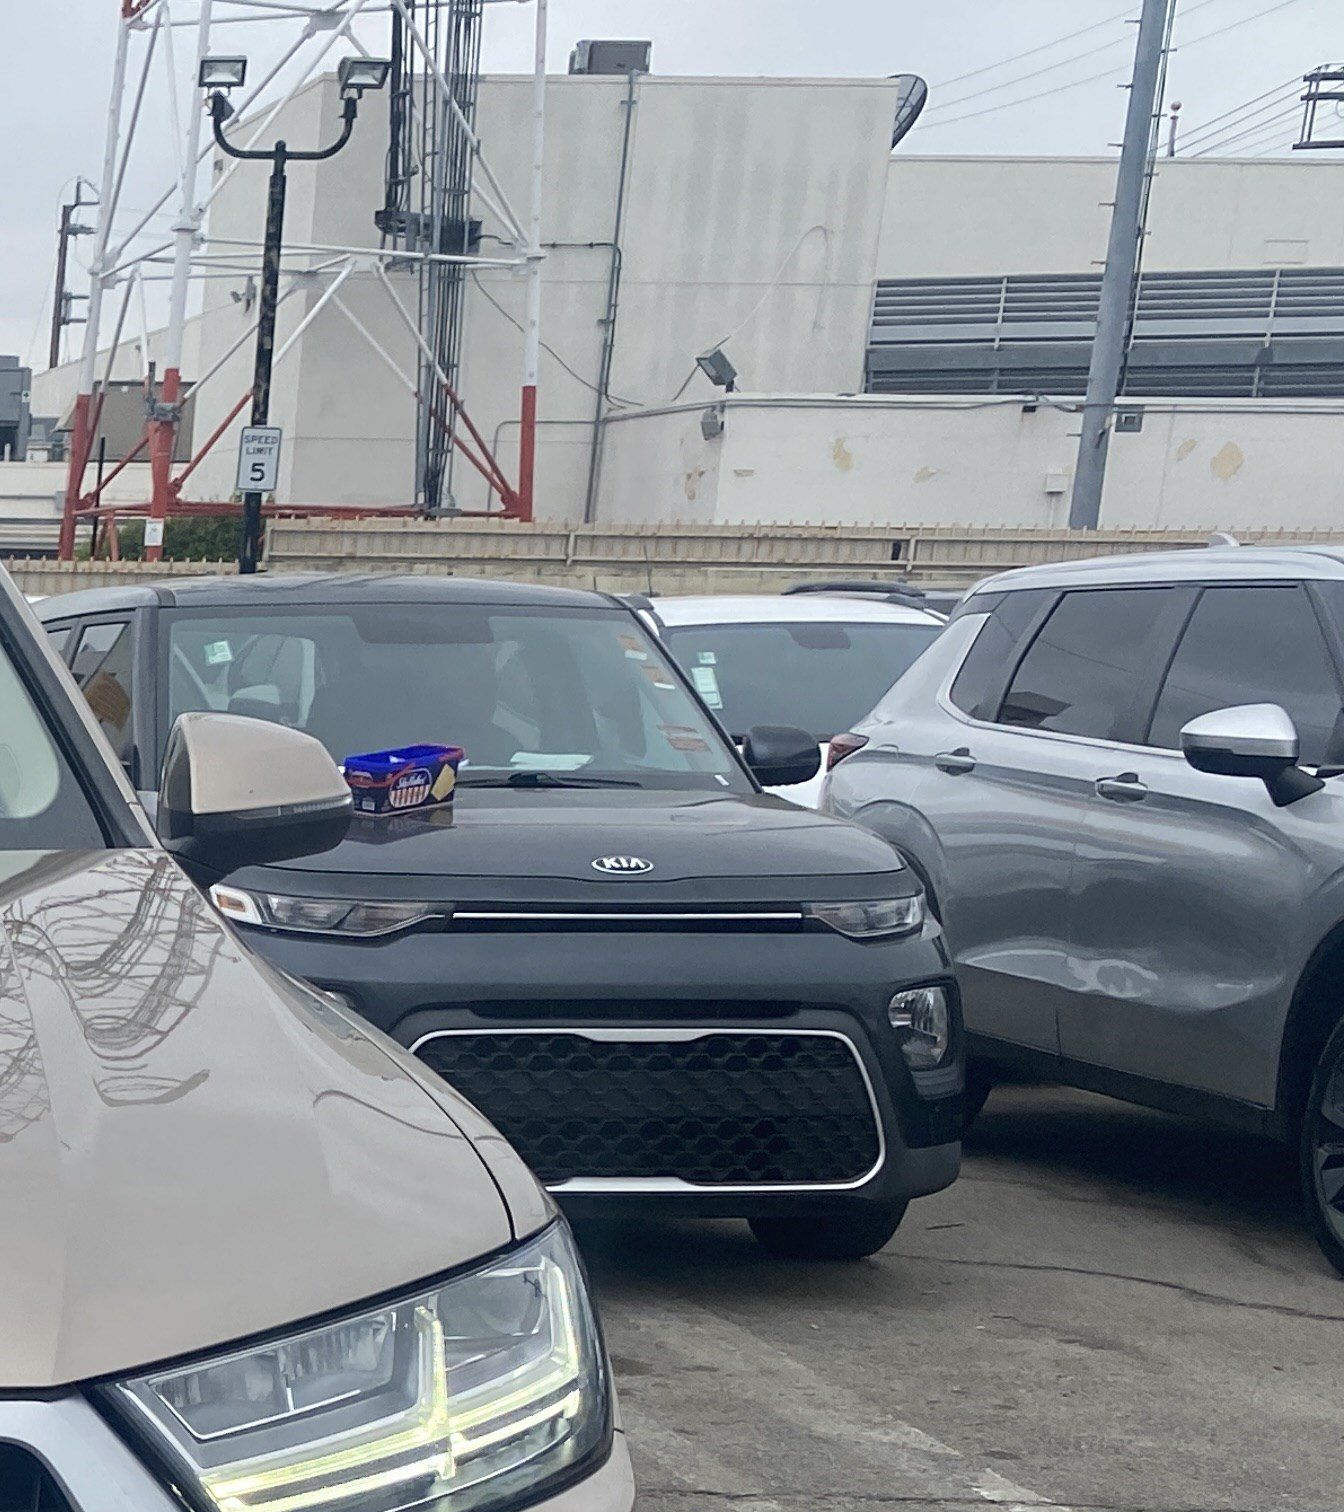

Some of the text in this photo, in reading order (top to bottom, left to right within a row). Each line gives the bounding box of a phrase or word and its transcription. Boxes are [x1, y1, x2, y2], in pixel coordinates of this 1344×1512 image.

[243, 435, 279, 445] SPEED
[245, 447, 273, 456] LIMIT
[250, 462, 265, 482] 5
[603, 857, 646, 868] KIA
